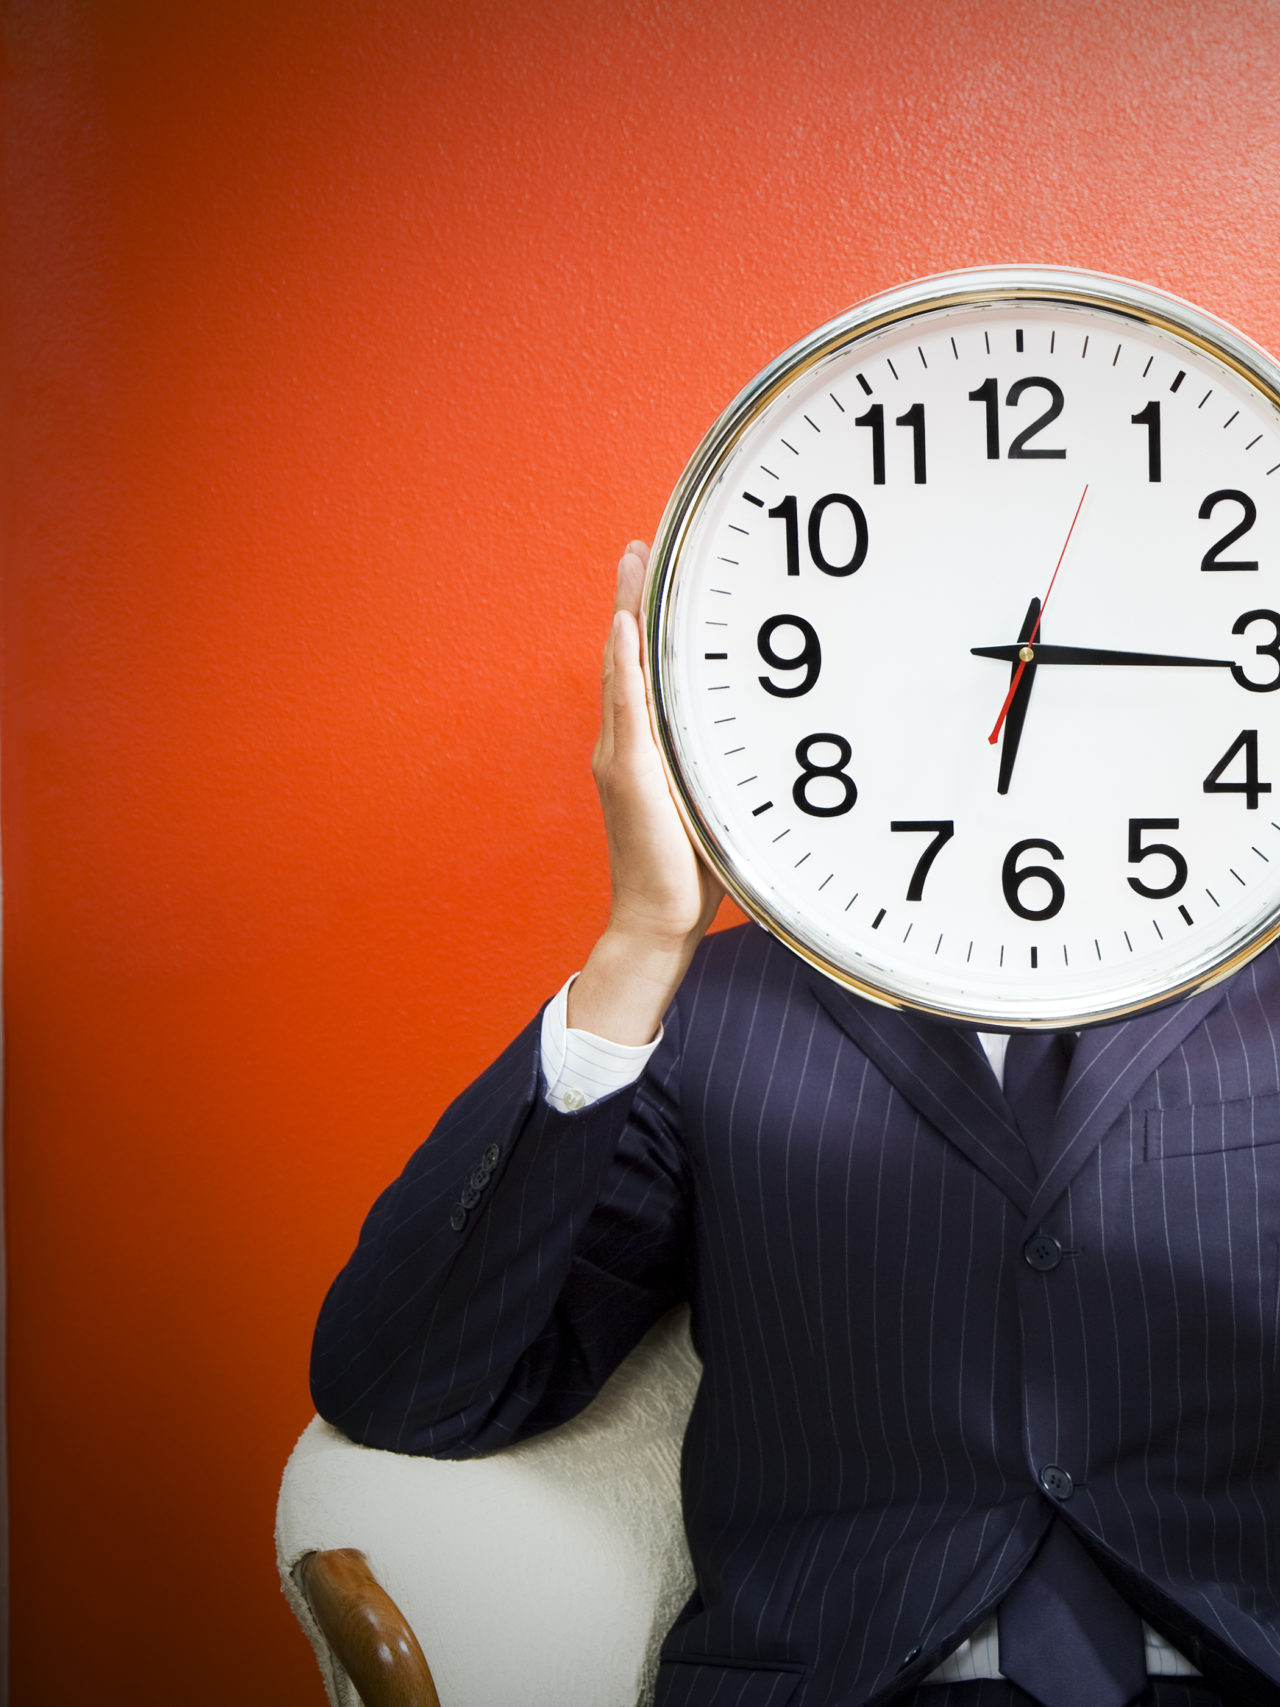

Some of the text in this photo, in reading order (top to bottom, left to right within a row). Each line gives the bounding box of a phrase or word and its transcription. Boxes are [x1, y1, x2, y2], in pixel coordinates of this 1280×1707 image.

[855, 403, 927, 485] 11
[968, 376, 1067, 460] 12
[1131, 400, 1162, 483] 1
[768, 493, 869, 578] 10
[1198, 489, 1259, 572] 2
[757, 614, 822, 699] 9
[792, 732, 858, 818] 8
[1202, 729, 1272, 810] 4
[890, 820, 955, 902] 7
[1001, 838, 1065, 922] 6
[1127, 818, 1188, 900] 5
